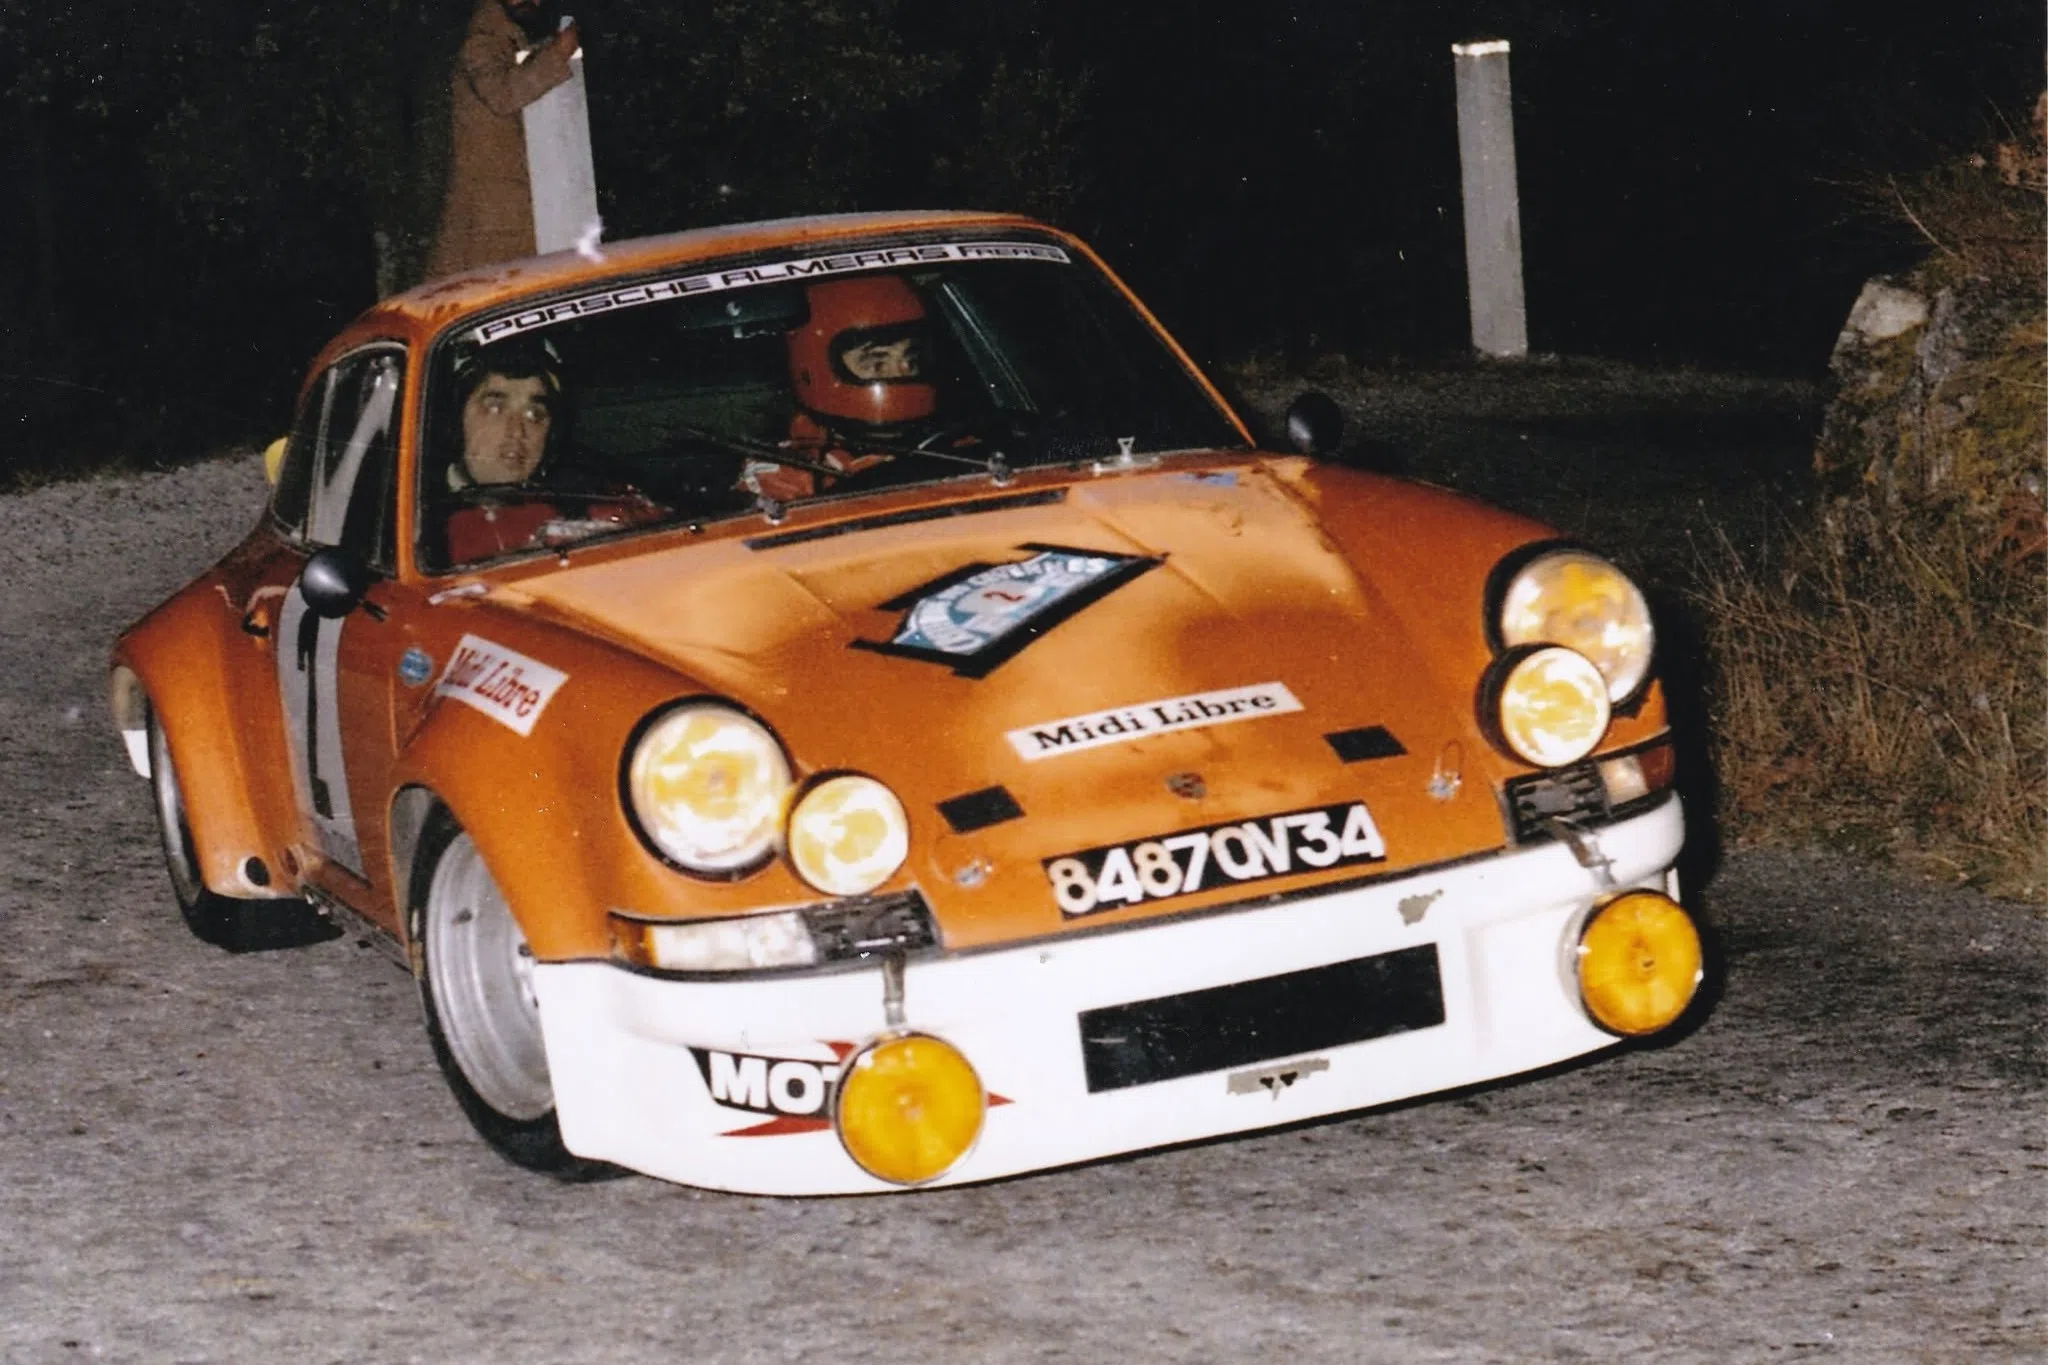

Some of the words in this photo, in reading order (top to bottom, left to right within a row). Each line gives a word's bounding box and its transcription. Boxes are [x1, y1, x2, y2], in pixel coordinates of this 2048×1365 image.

[481, 276, 712, 340] PORSCHE
[720, 247, 950, 287] ALMERAS
[1033, 710, 1143, 750] Midi
[1150, 691, 1278, 726] Libre
[1048, 803, 1387, 914] 8487QV34
